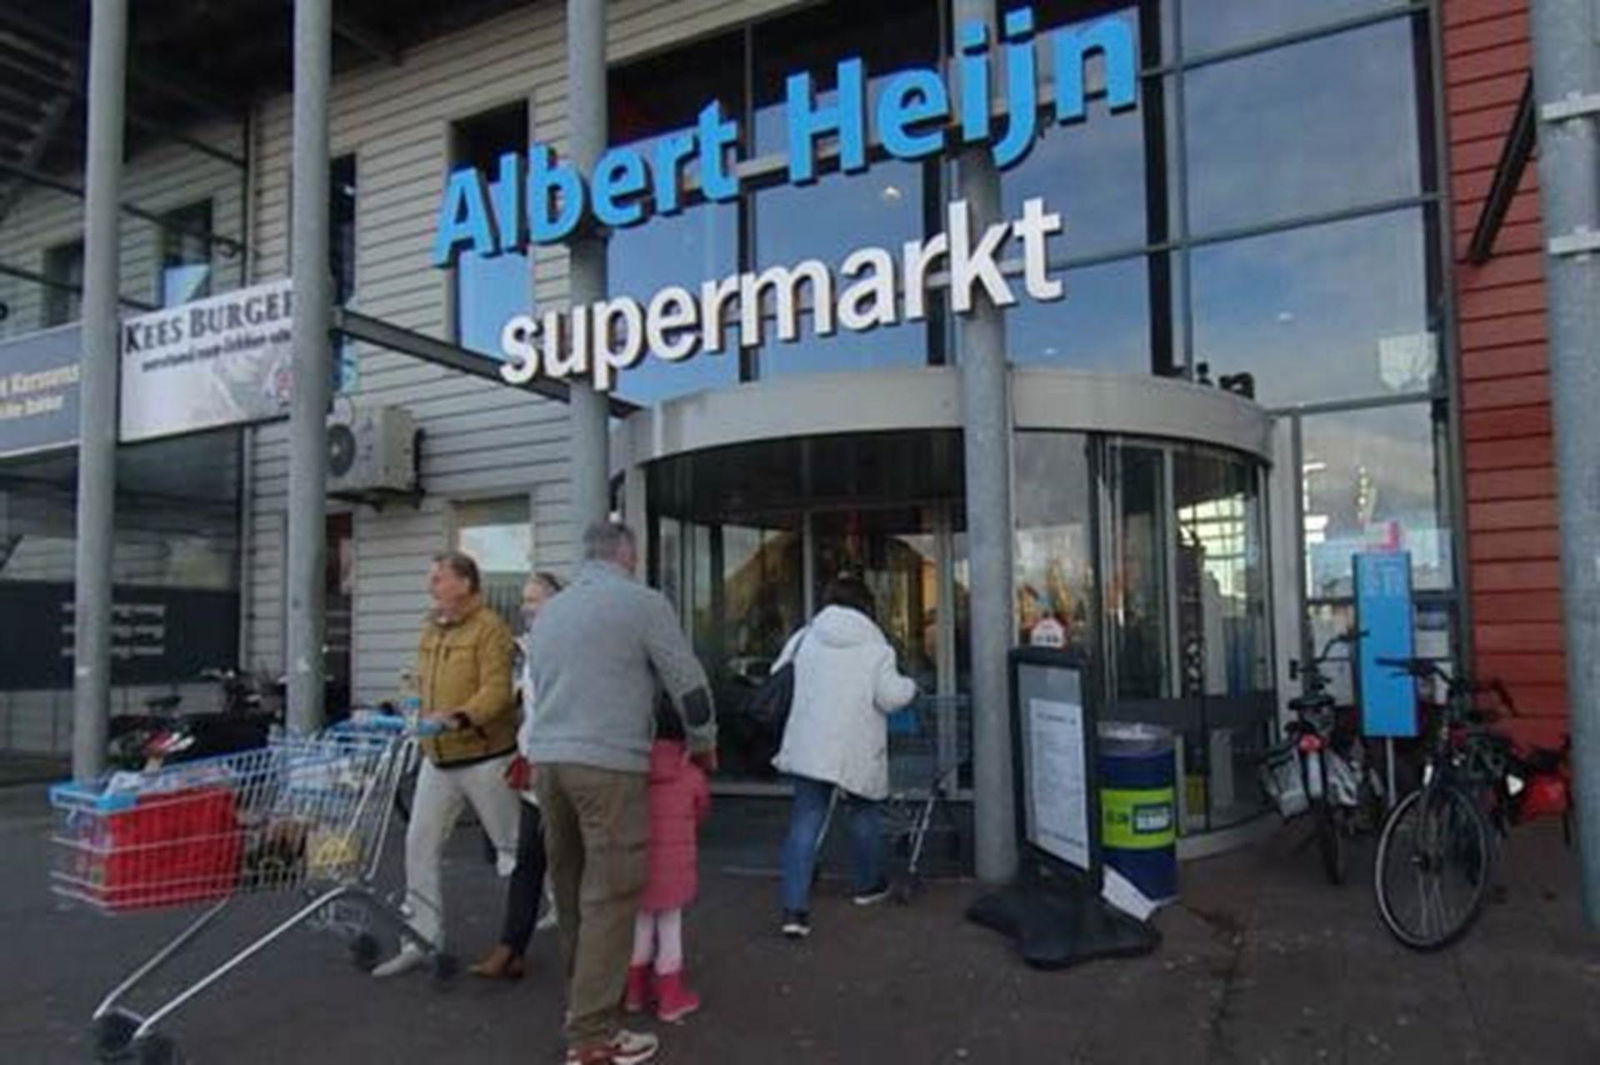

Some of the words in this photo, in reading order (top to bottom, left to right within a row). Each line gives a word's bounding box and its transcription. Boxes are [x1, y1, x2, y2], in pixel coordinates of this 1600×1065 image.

[431, 100, 739, 267] Albert
[786, 7, 1139, 184] Heijn
[125, 316, 183, 354] KEES
[499, 197, 1063, 391] supermarkt
